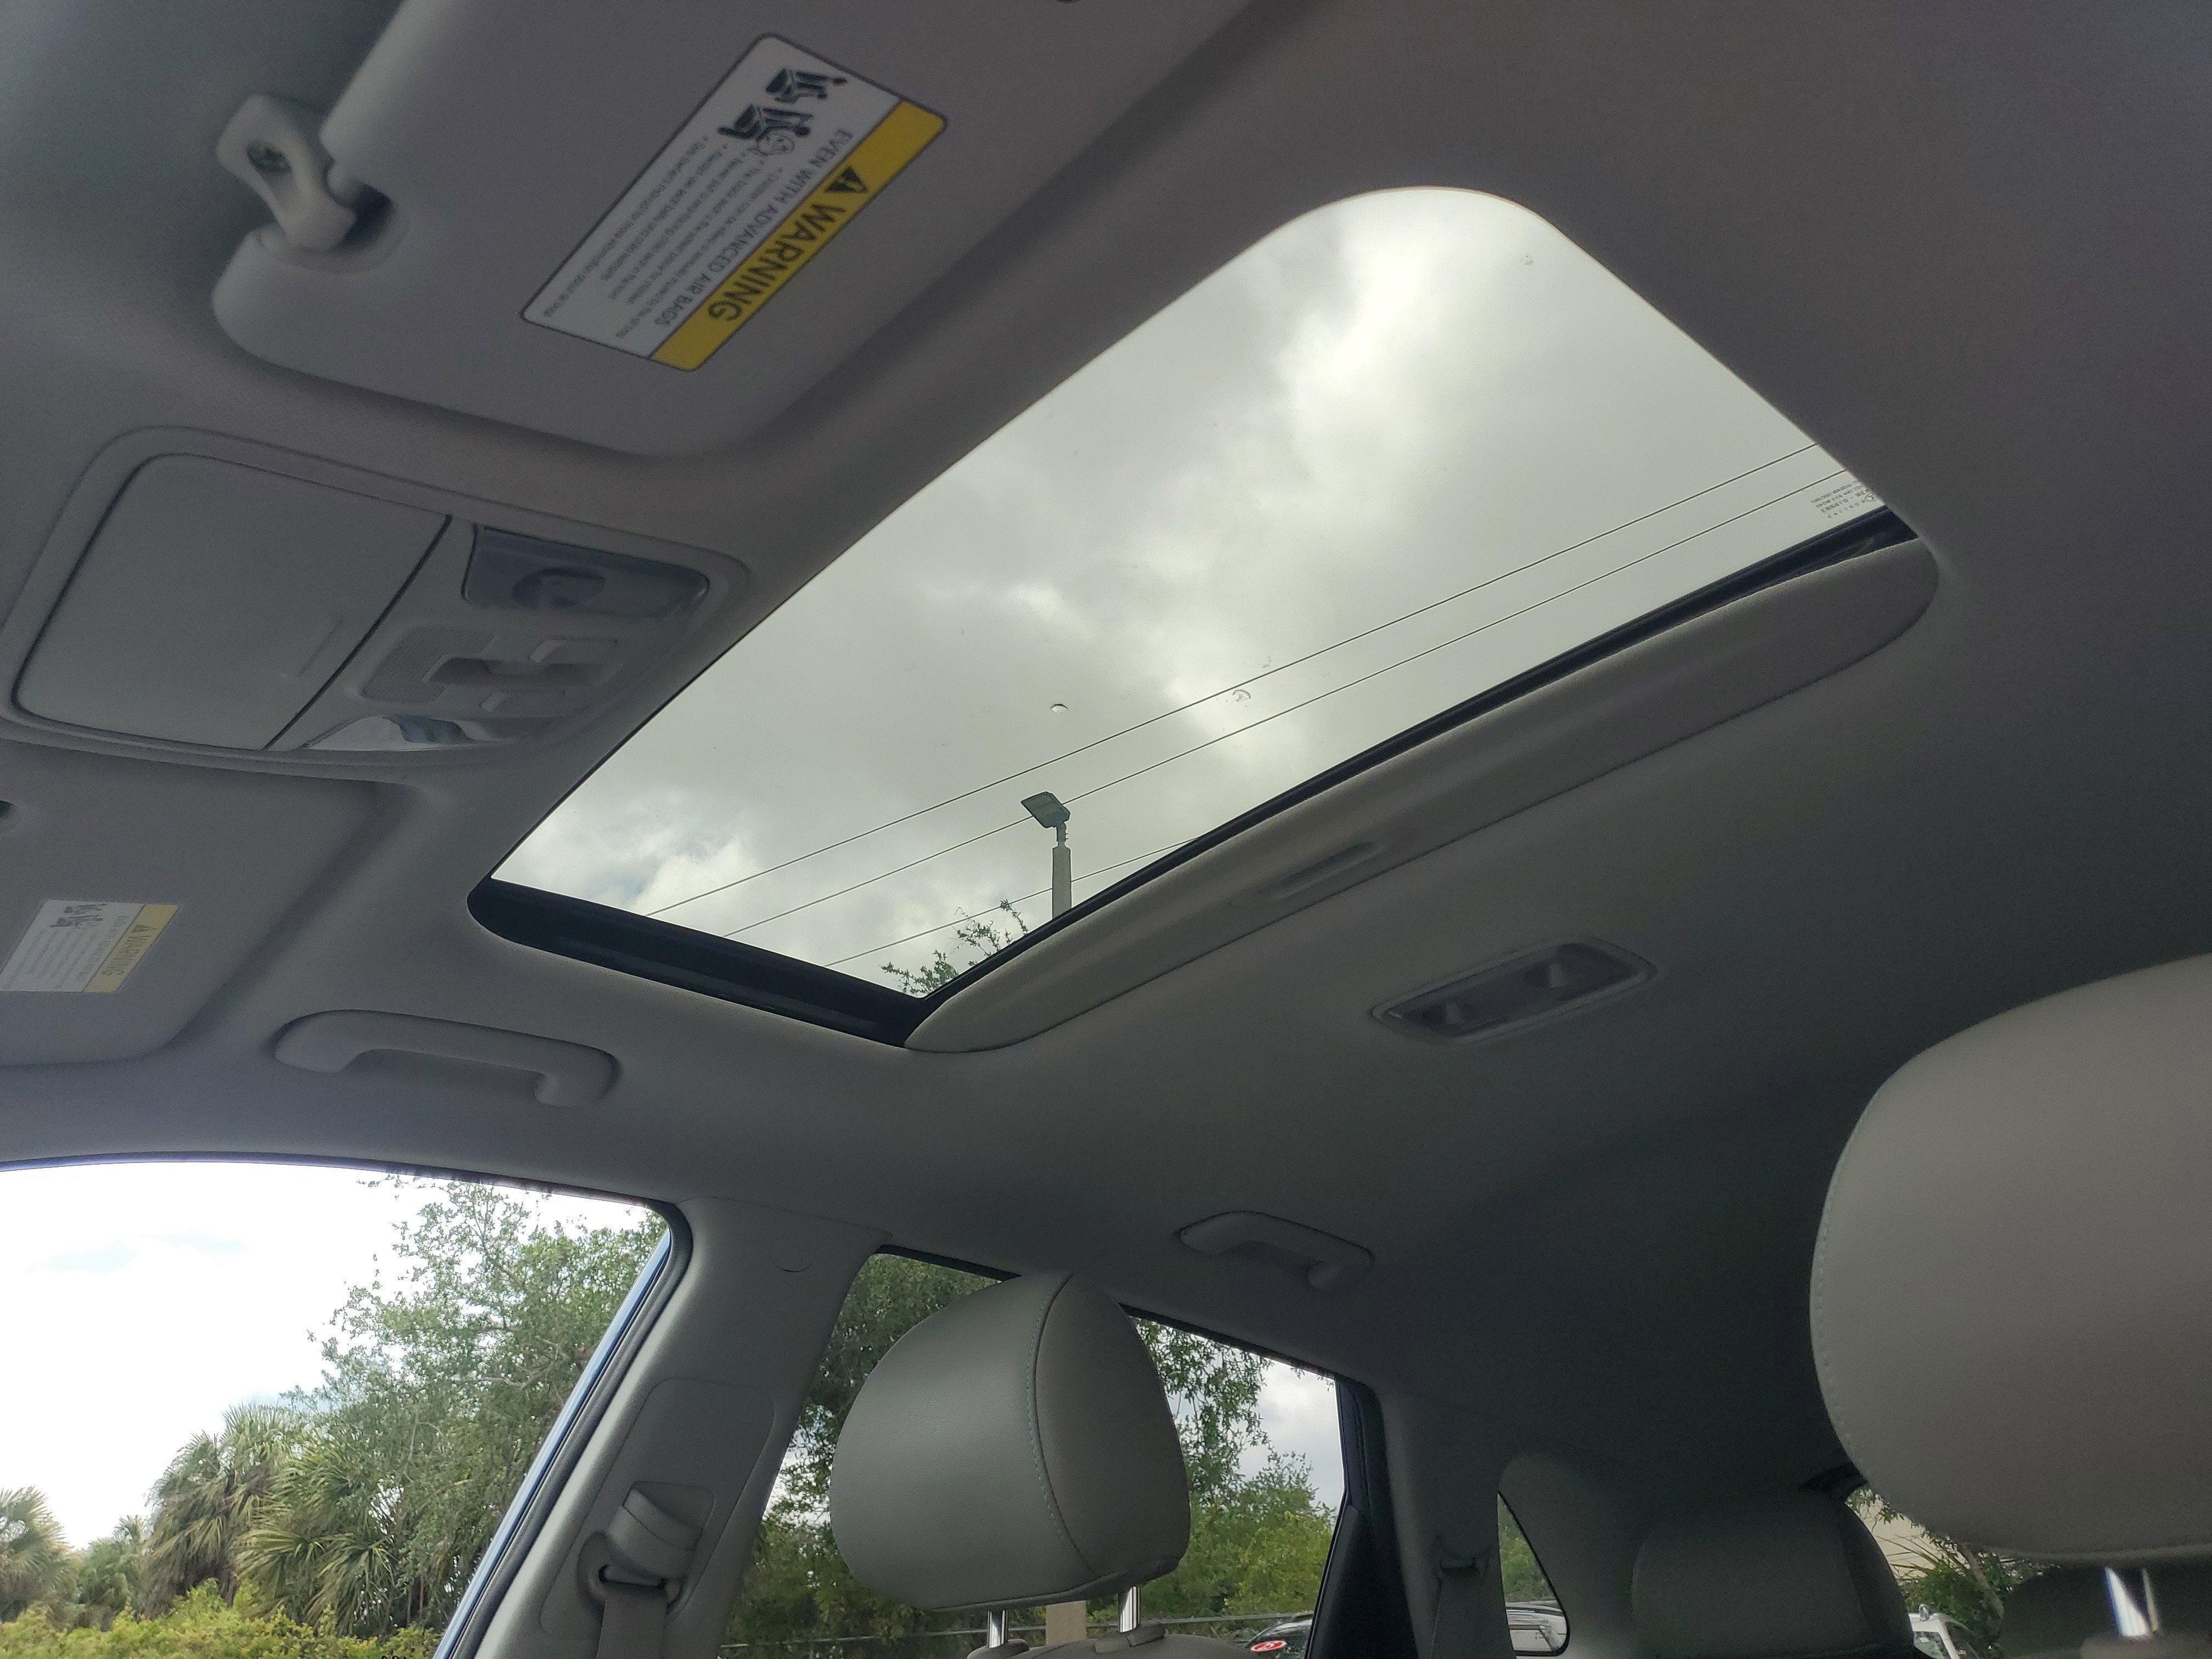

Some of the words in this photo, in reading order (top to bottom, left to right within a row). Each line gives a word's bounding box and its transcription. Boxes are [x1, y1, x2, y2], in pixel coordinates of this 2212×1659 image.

[807, 127, 854, 168] EVEN
[772, 168, 814, 204] WITH
[707, 203, 778, 273] ADVANCED
[706, 202, 847, 323] WARNING
[685, 272, 713, 295] AIR
[653, 295, 693, 326] BAGS
